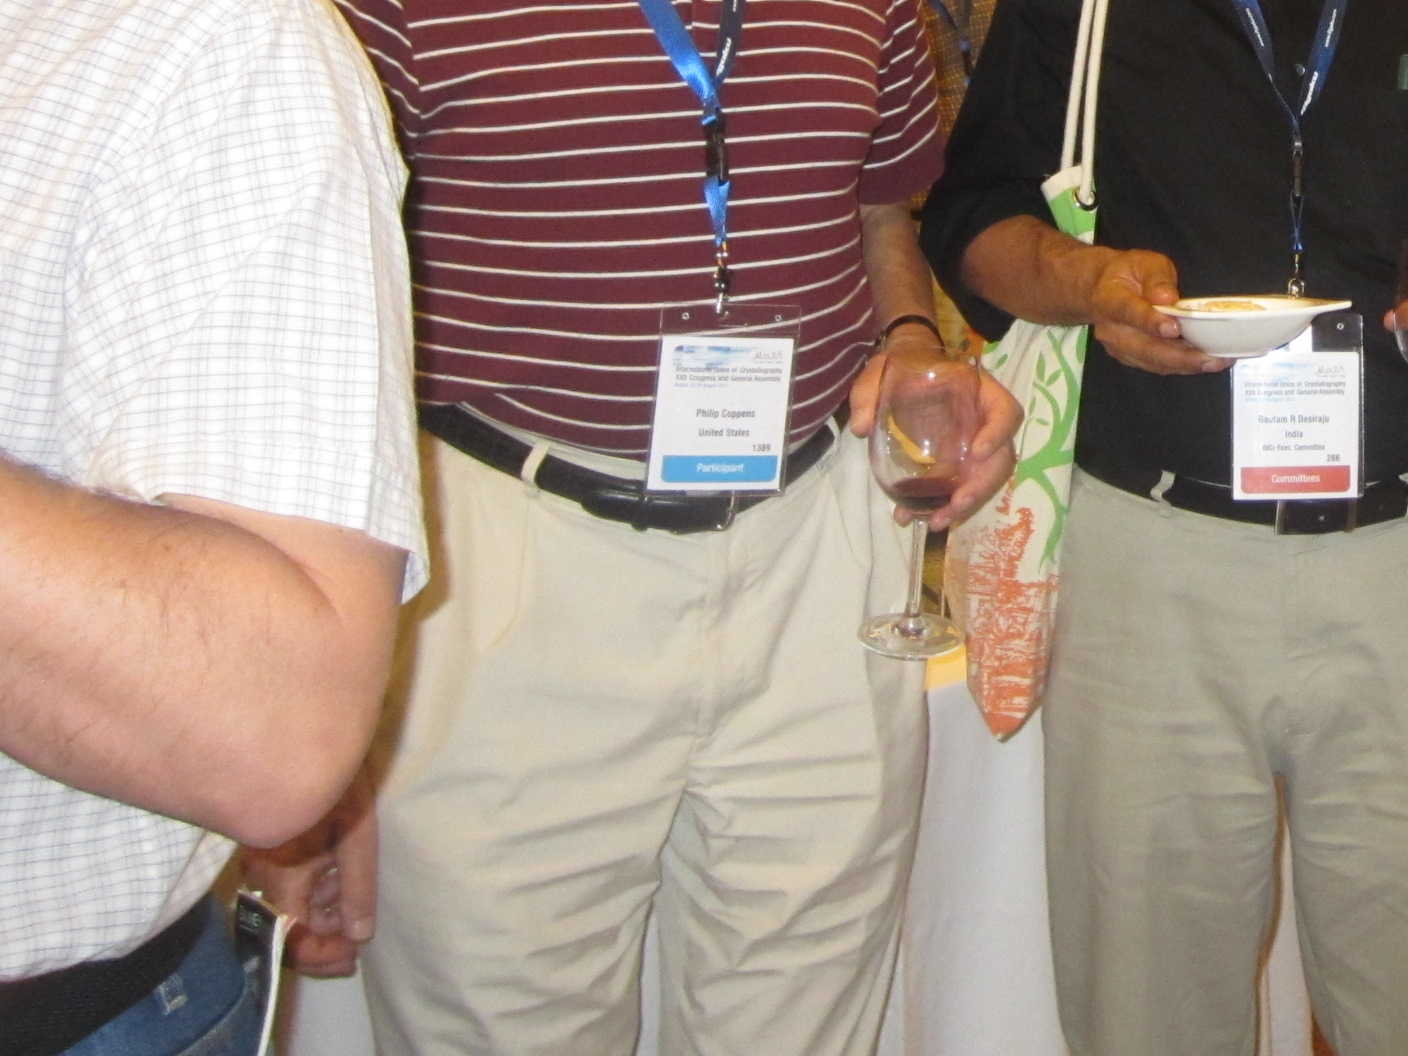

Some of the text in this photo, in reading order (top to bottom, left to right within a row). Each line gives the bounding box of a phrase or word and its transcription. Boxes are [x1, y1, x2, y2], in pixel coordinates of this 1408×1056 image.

[696, 407, 756, 419] Philip Coppens
[1290, 415, 1296, 424] R
[1297, 415, 1330, 425] Desiraju
[698, 428, 750, 437] United States
[1284, 431, 1304, 439] India
[696, 462, 744, 473] Participant
